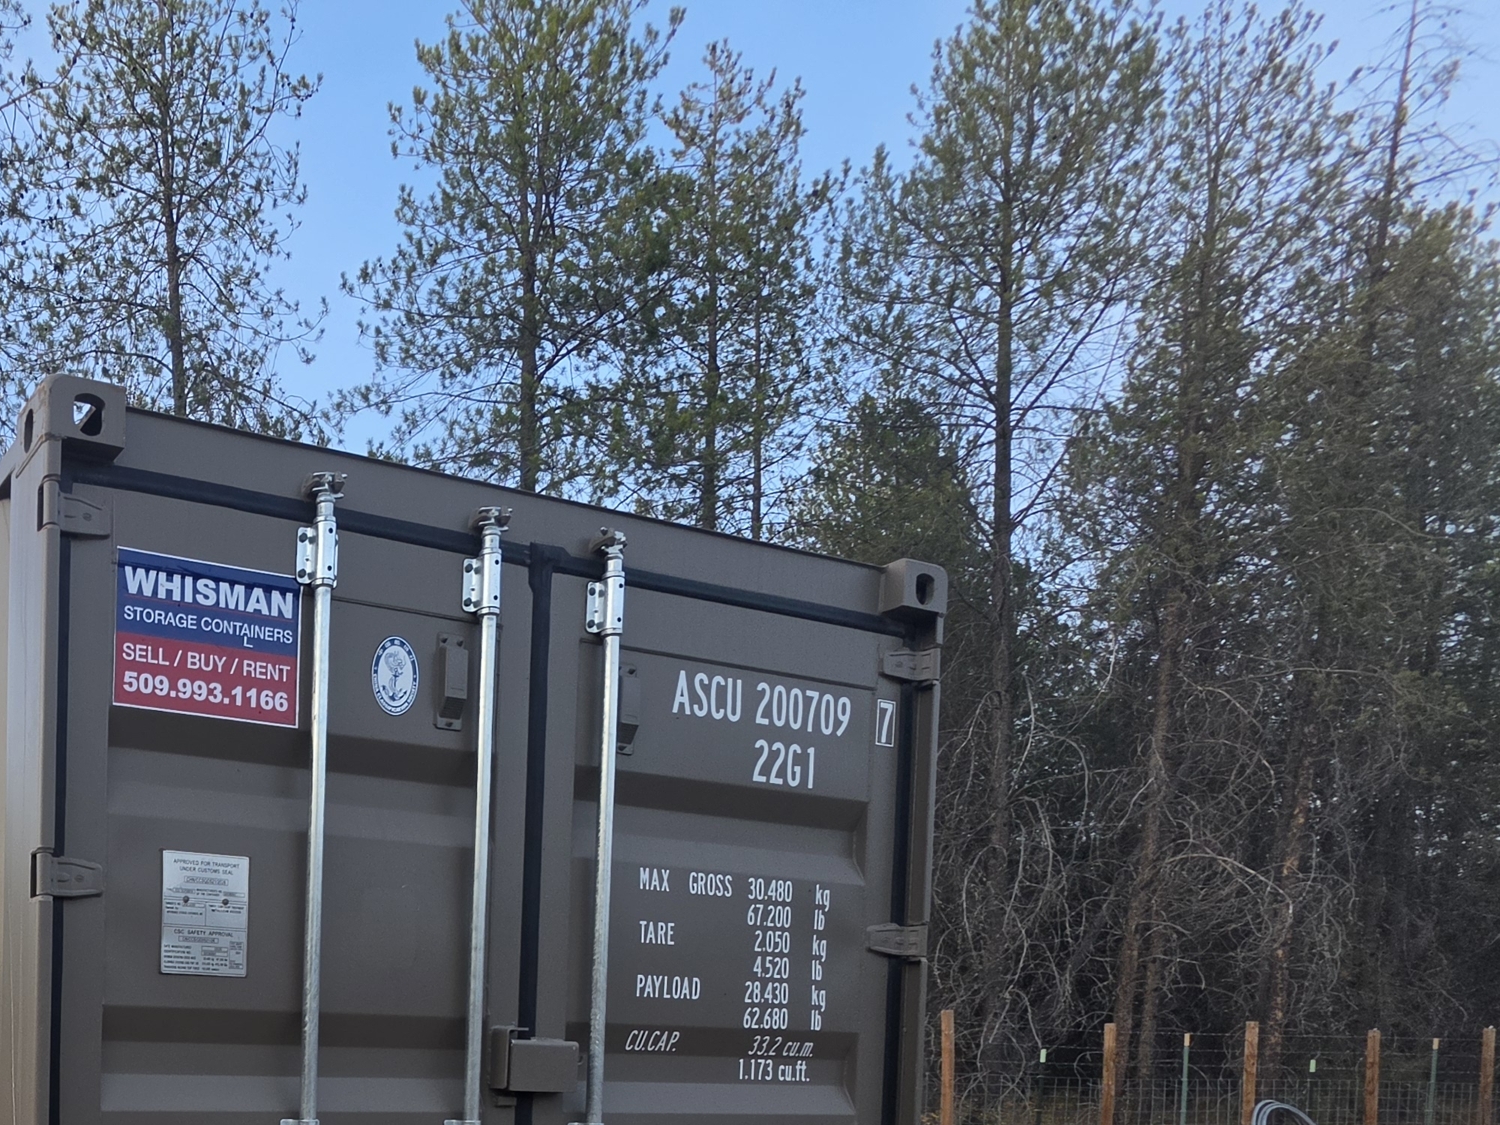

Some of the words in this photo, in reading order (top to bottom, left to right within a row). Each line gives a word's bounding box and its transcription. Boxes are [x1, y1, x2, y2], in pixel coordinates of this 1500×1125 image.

[124, 566, 294, 619] WHISMAN
[123, 605, 198, 630] STORAGE
[200, 617, 293, 644] CONTAINERS
[122, 642, 170, 666] SELL
[173, 650, 183, 667] /
[187, 651, 227, 673] BUY
[230, 658, 239, 675] /
[243, 660, 291, 682] RENT
[122, 670, 289, 712] 509.993.1166
[671, 669, 742, 723] ASCU
[755, 681, 851, 737] 200709
[879, 701, 894, 743] 7
[752, 738, 816, 789] 22G1
[173, 858, 199, 866] APPROVED
[212, 861, 240, 869] TRANSPORT
[639, 867, 670, 892] MAX
[688, 871, 733, 898] GROSS
[747, 877, 793, 902] 30.480
[815, 884, 831, 911] kg
[208, 930, 234, 938] APPROVAL
[747, 904, 792, 928] 67.200
[813, 909, 825, 931] lb
[639, 920, 675, 946] TARE
[754, 930, 790, 953] 2.050
[812, 934, 827, 962] kg
[753, 956, 790, 979] 4.520
[811, 960, 823, 981] lb
[636, 974, 701, 1000] PAYLOAD
[744, 981, 789, 1004] 28.430
[811, 985, 826, 1012] kg
[743, 1007, 788, 1029] 62.680
[810, 1010, 822, 1031] lb
[625, 1030, 680, 1052] CU.CAP.
[748, 1035, 782, 1056] 33.2
[782, 1039, 814, 1057] cu.m.
[738, 1058, 773, 1080] 1.173
[778, 1060, 811, 1082] cu.ft.
